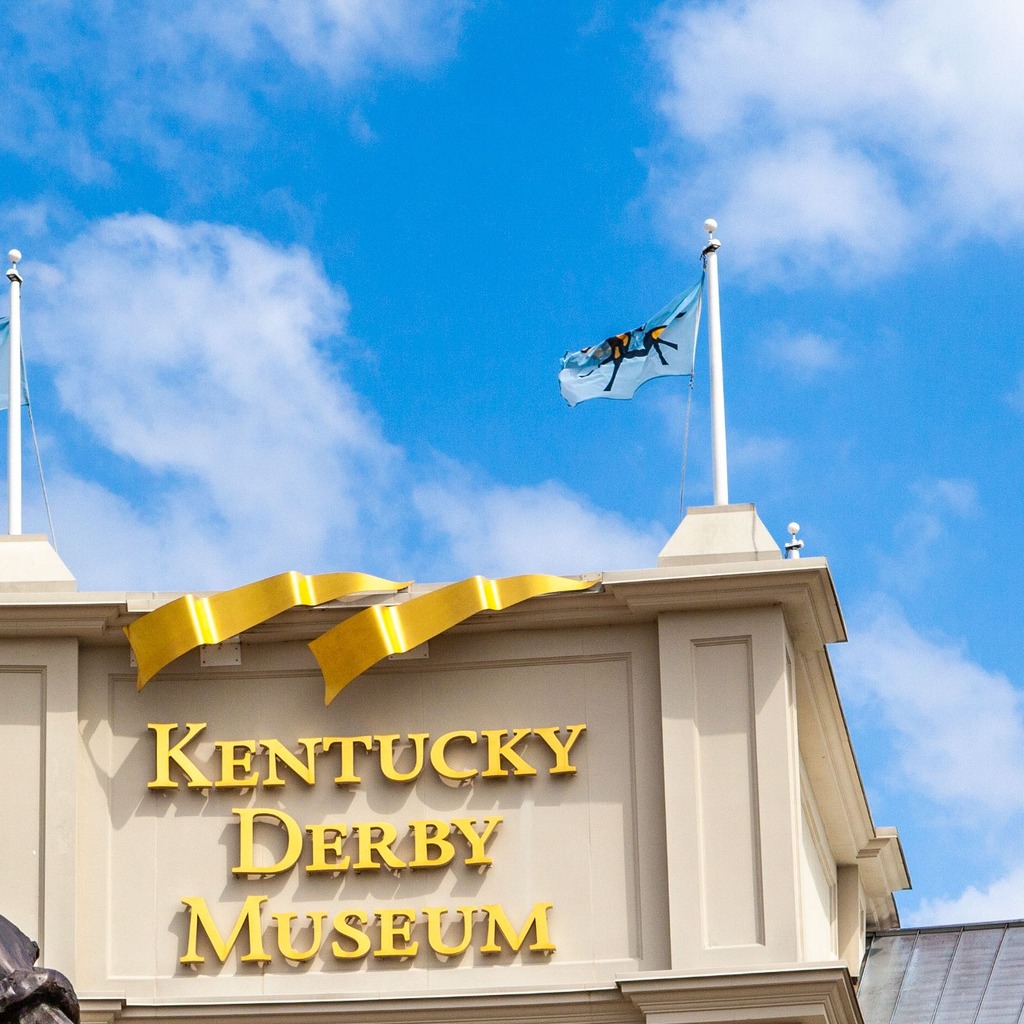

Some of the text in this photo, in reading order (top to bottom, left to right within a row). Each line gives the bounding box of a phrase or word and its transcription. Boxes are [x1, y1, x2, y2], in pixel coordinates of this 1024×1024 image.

[147, 722, 586, 790] KENTUCKY
[232, 807, 503, 876] DERBY
[179, 895, 557, 965] MUSEUM
